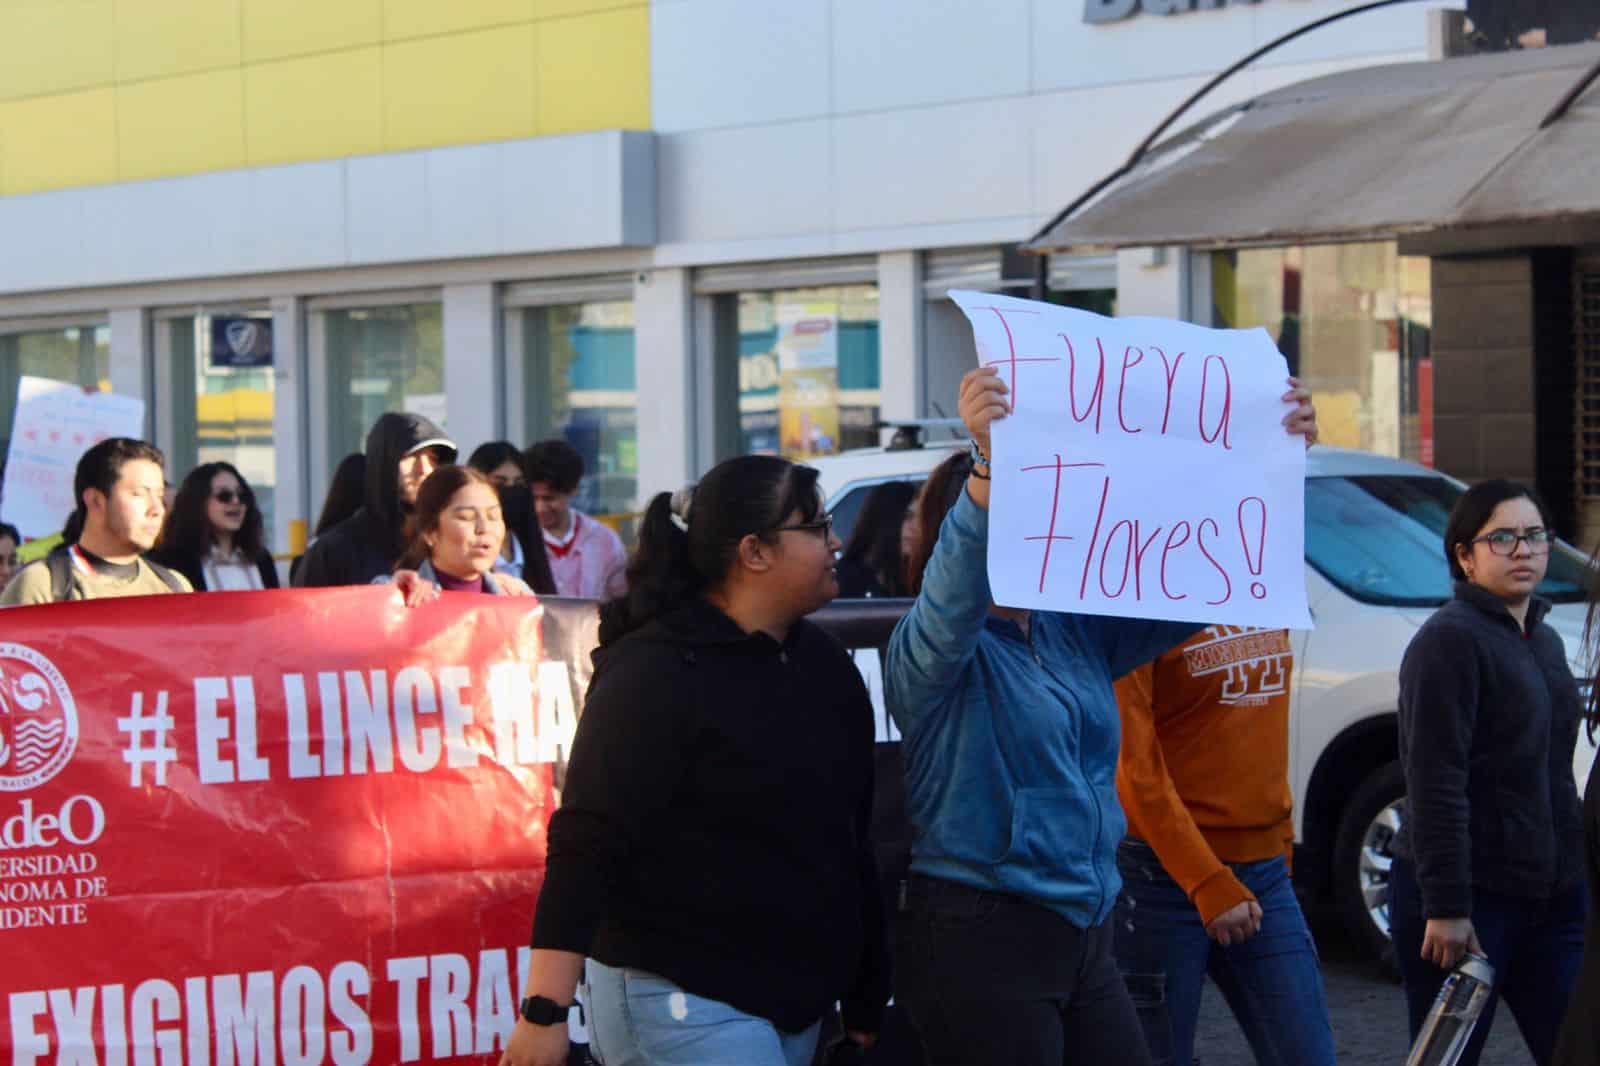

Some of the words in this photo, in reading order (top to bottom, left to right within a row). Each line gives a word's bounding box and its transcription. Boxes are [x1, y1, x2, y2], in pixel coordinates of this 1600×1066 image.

[971, 306, 1234, 450] Fuera
[1020, 454, 1268, 605] Flores!
[194, 676, 270, 785] EL
[282, 665, 479, 779] LINCE
[74, 876, 108, 899] DE
[9, 960, 375, 1066] EXIGIMOS
